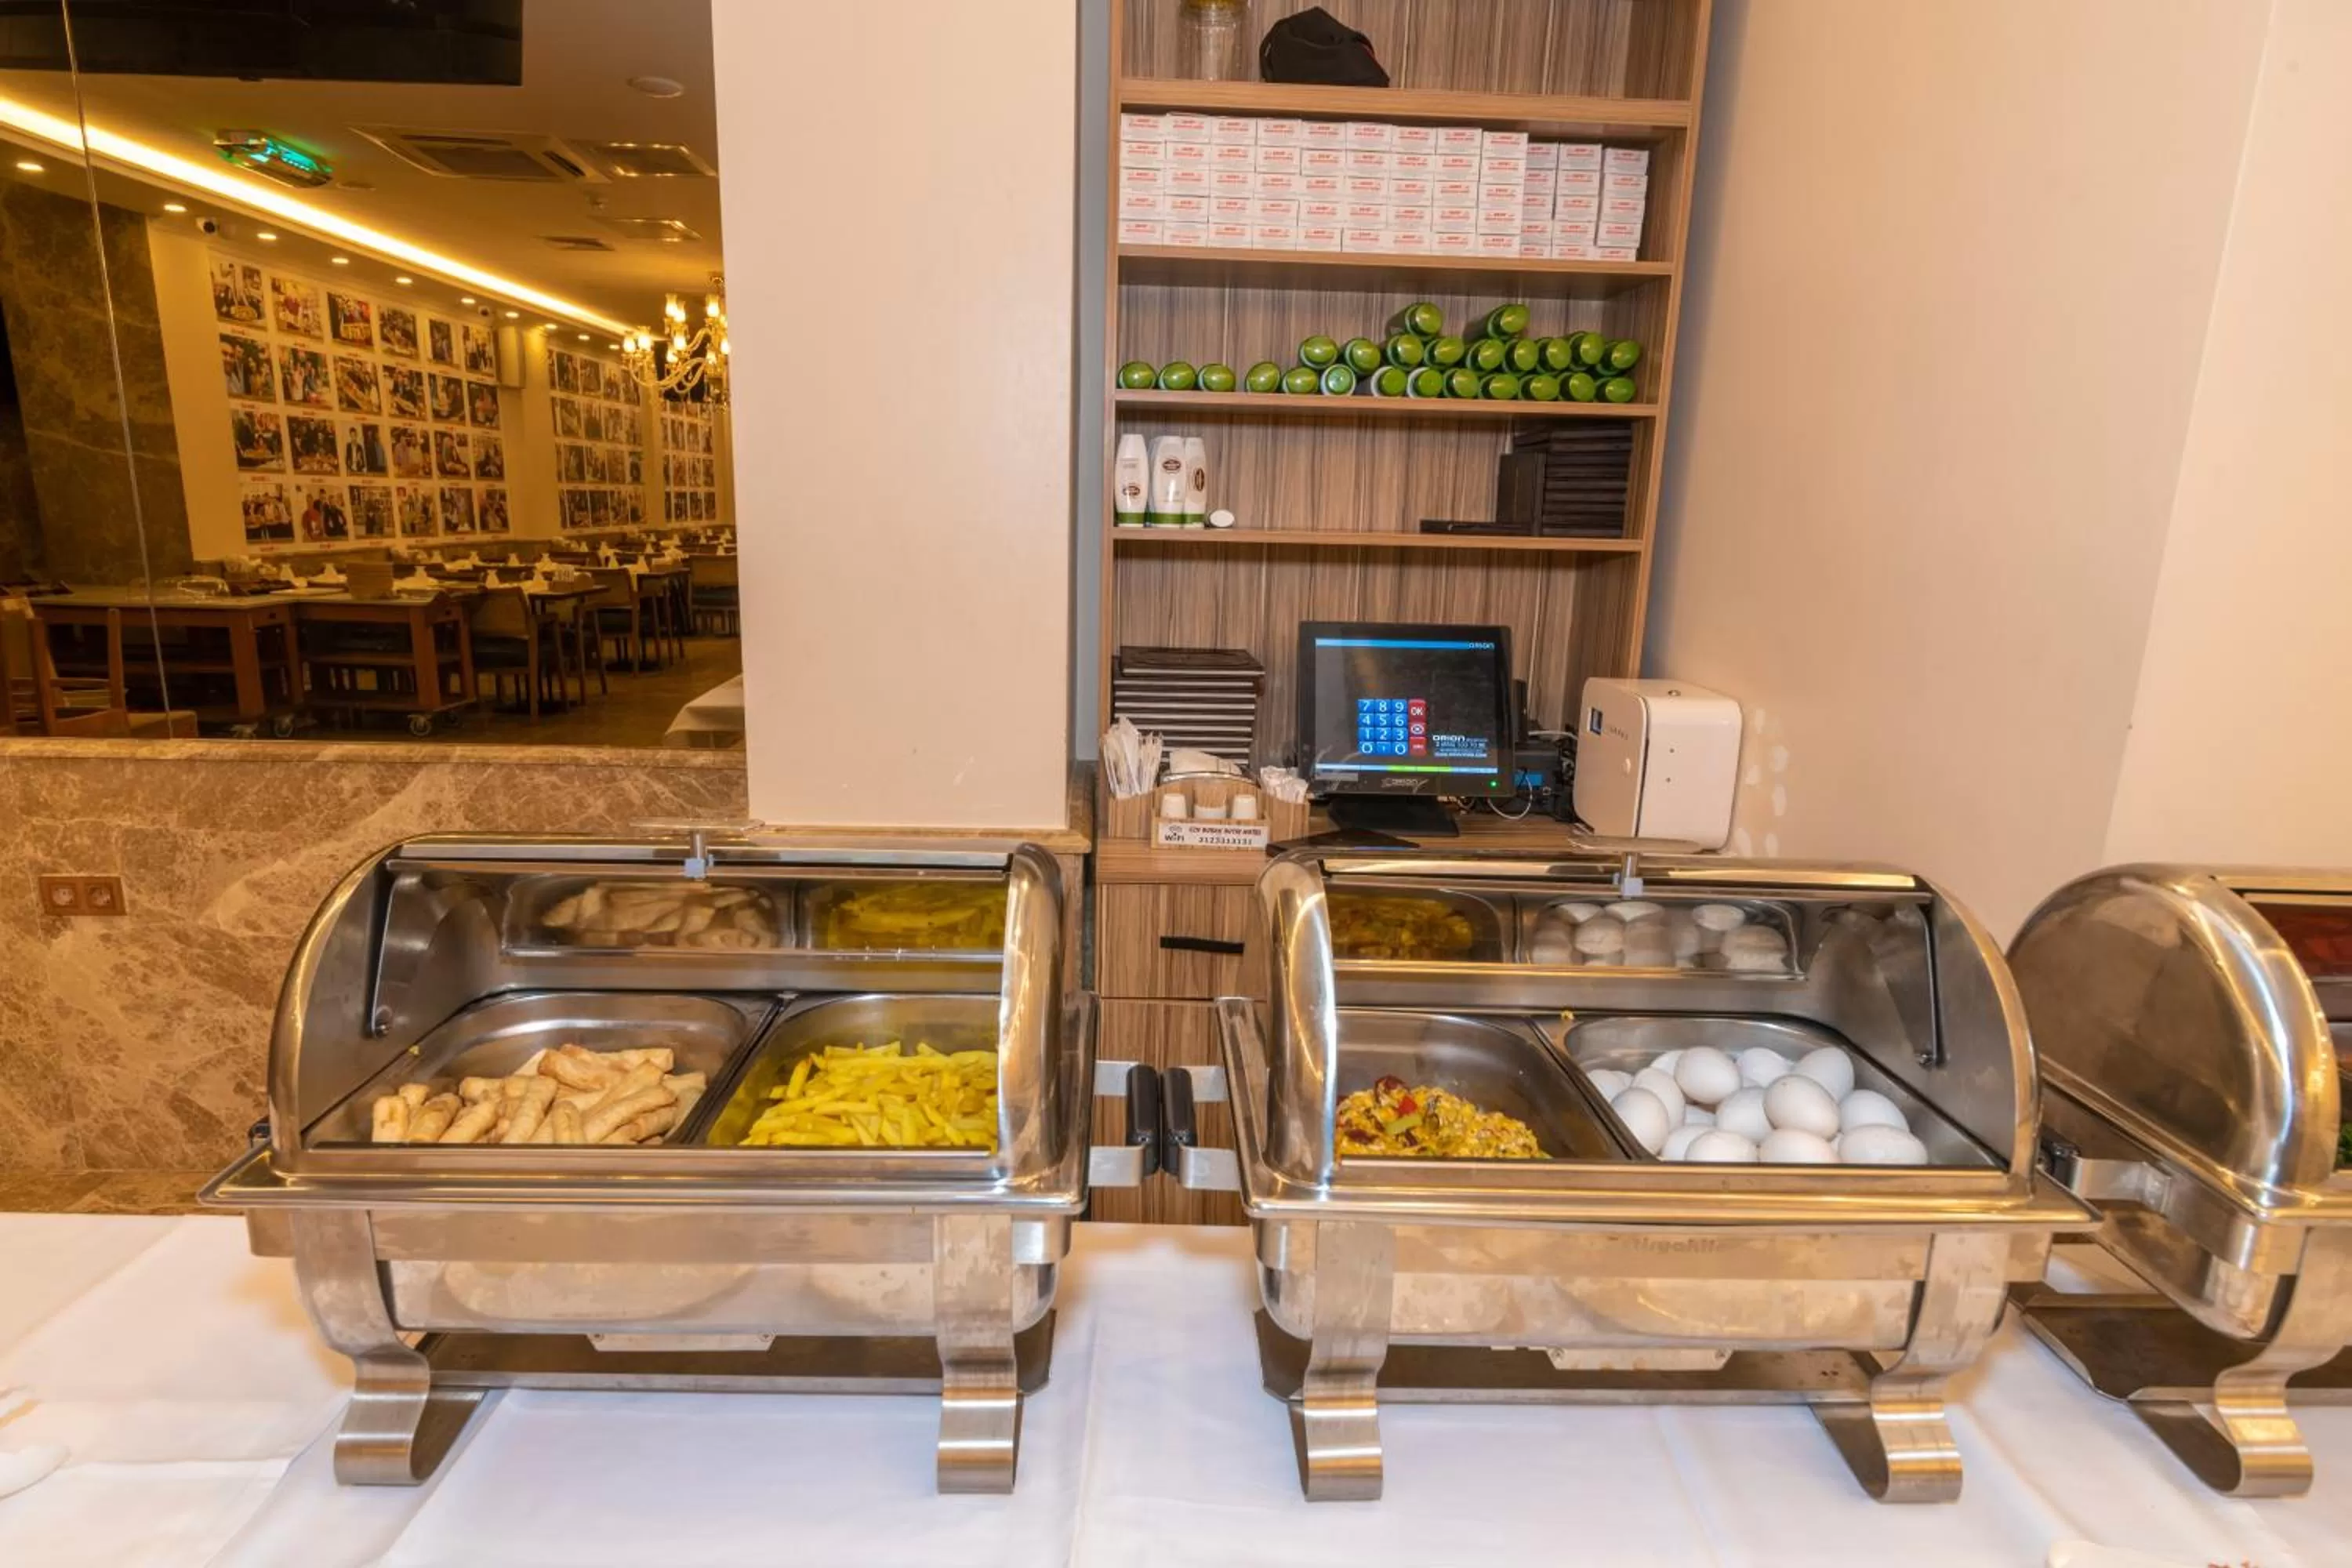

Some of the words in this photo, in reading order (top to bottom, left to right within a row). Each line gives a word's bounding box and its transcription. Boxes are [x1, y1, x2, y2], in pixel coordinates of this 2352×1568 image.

[1363, 699, 1370, 711] 7
[1379, 699, 1387, 713] 8
[1395, 701, 1404, 713] 9
[1410, 706, 1423, 716] OK
[1362, 714, 1370, 725] 4
[1379, 713, 1387, 727] 5
[1395, 715, 1404, 727] 6
[1379, 728, 1387, 740] 2
[1396, 729, 1404, 741] 3
